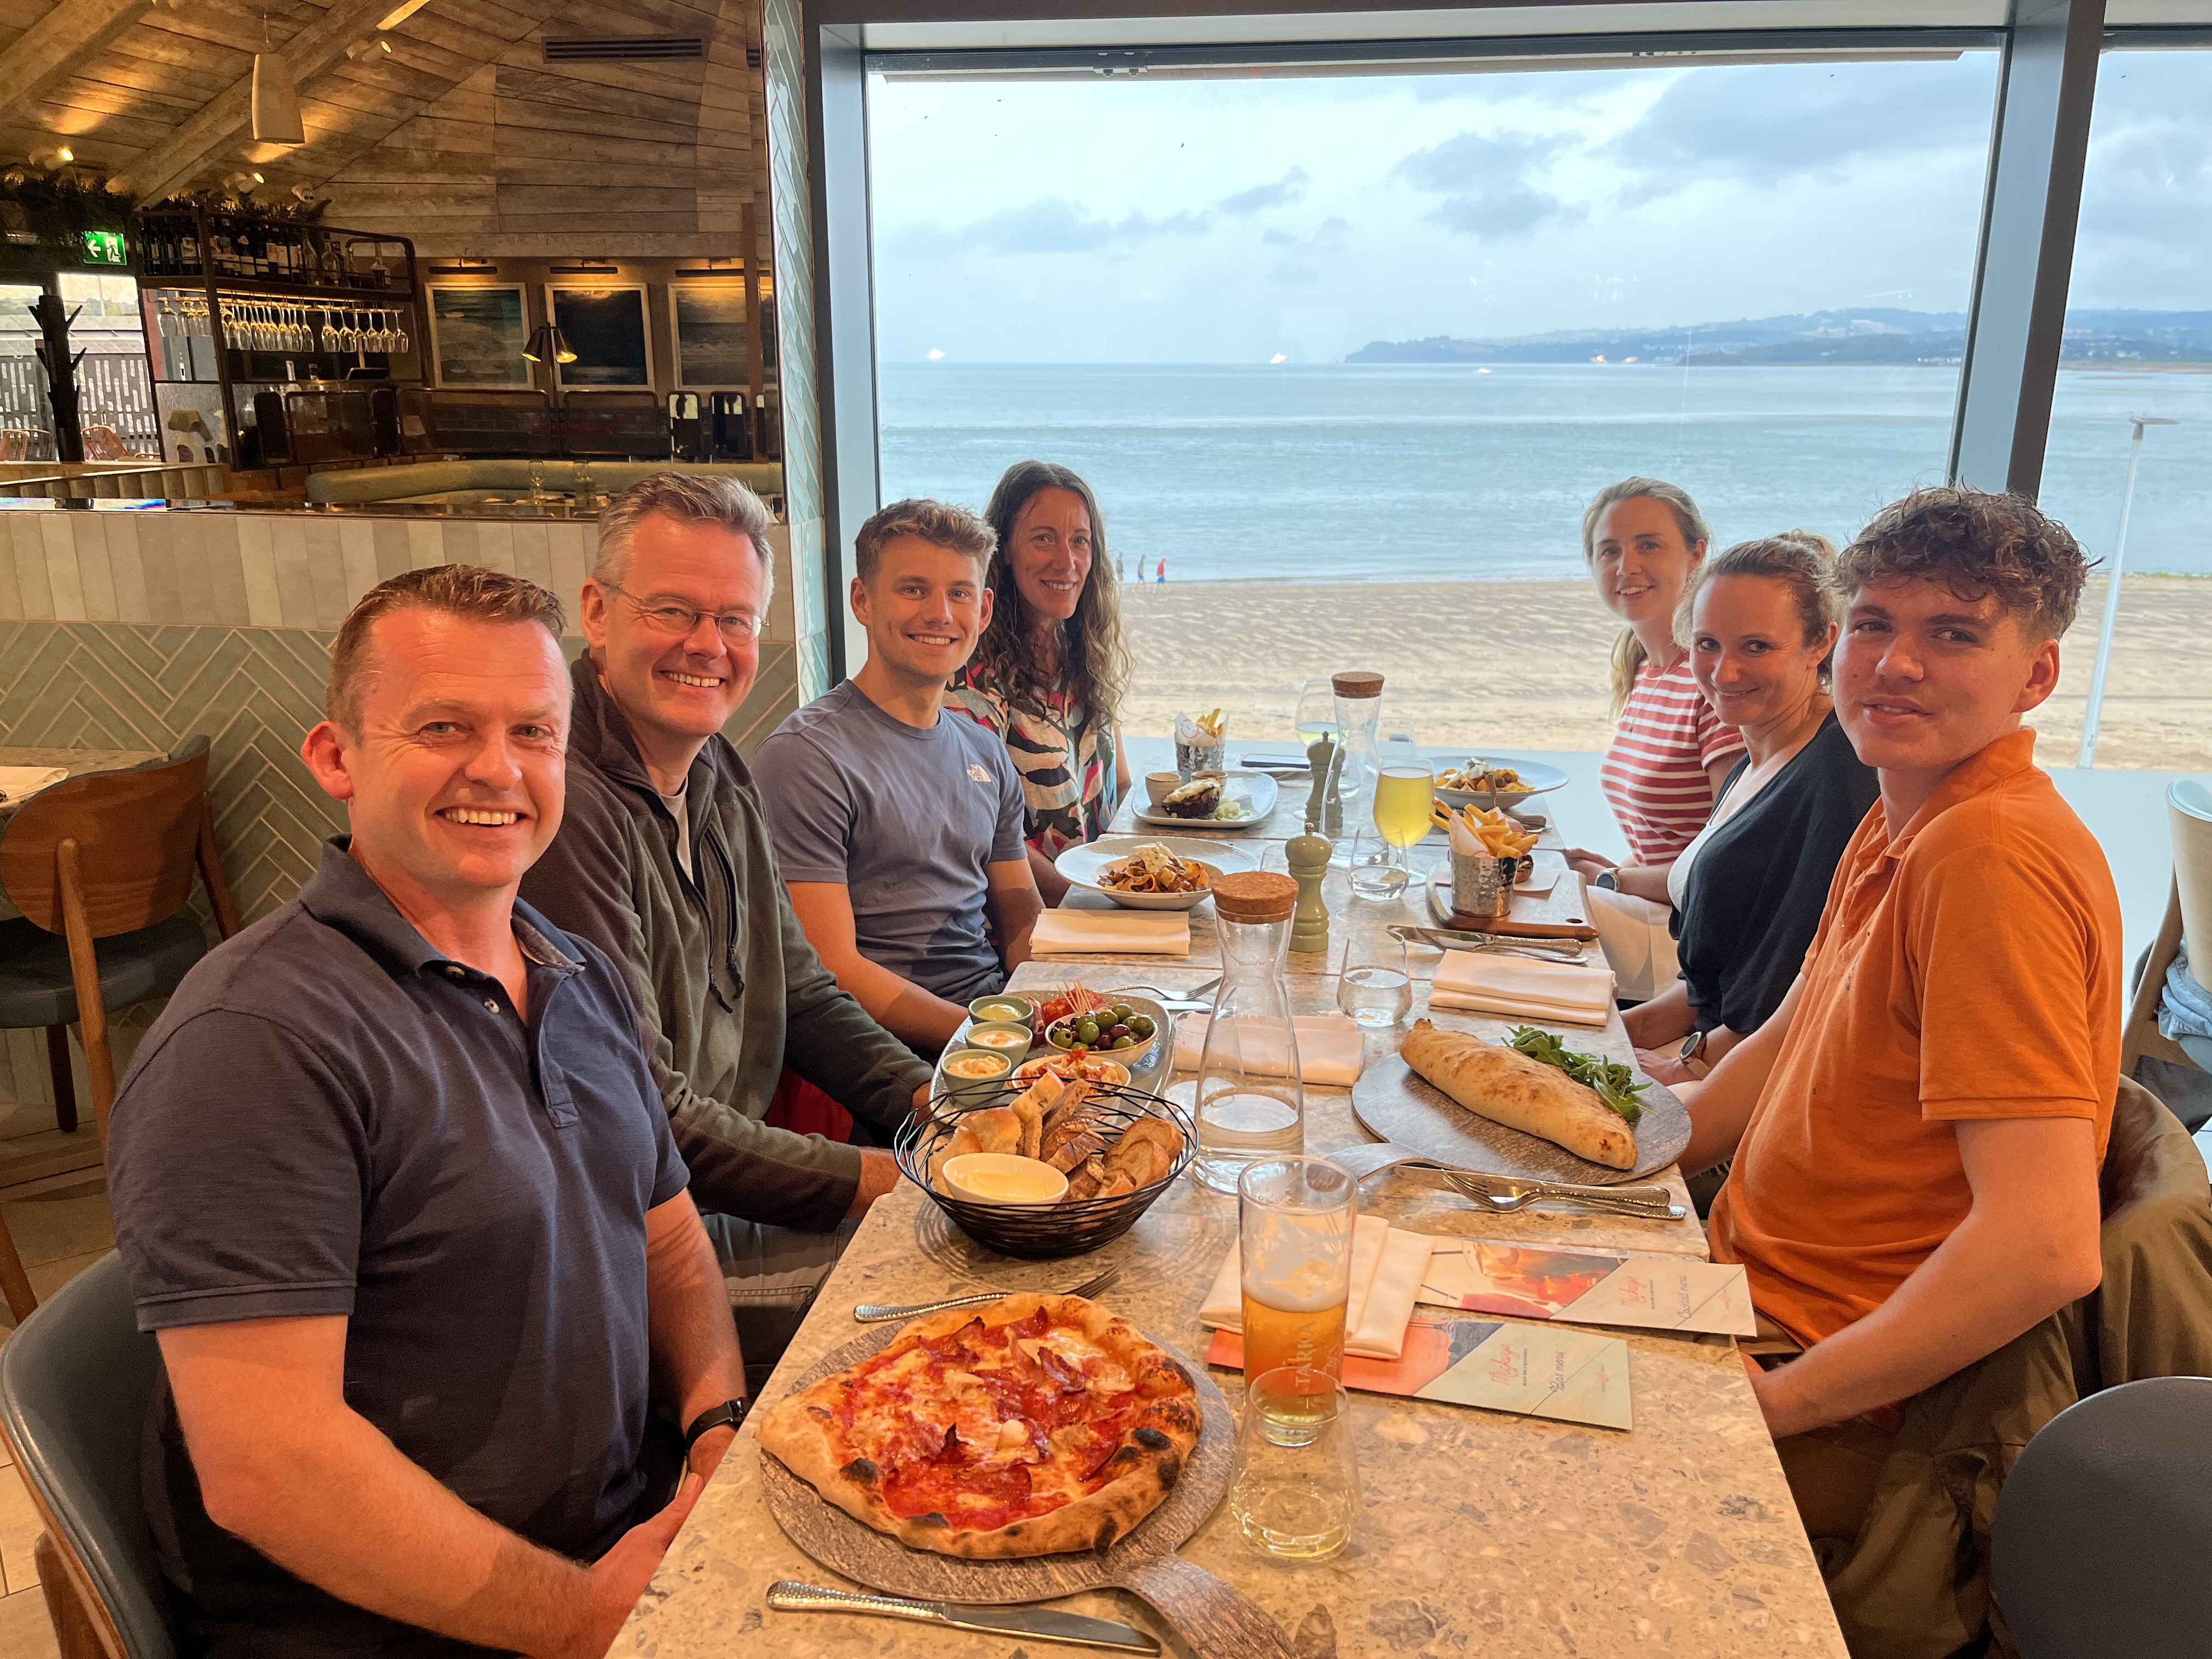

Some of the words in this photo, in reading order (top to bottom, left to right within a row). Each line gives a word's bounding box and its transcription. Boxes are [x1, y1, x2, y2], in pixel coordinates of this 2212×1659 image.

[1619, 1276, 1646, 1308] Mickeys
[1680, 1276, 1688, 1291] menu
[1677, 1292, 1691, 1318] Cocktail
[1295, 1321, 1317, 1387] TARKA
[1489, 1344, 1520, 1385] Mickeys
[1549, 1373, 1565, 1392] Bar
